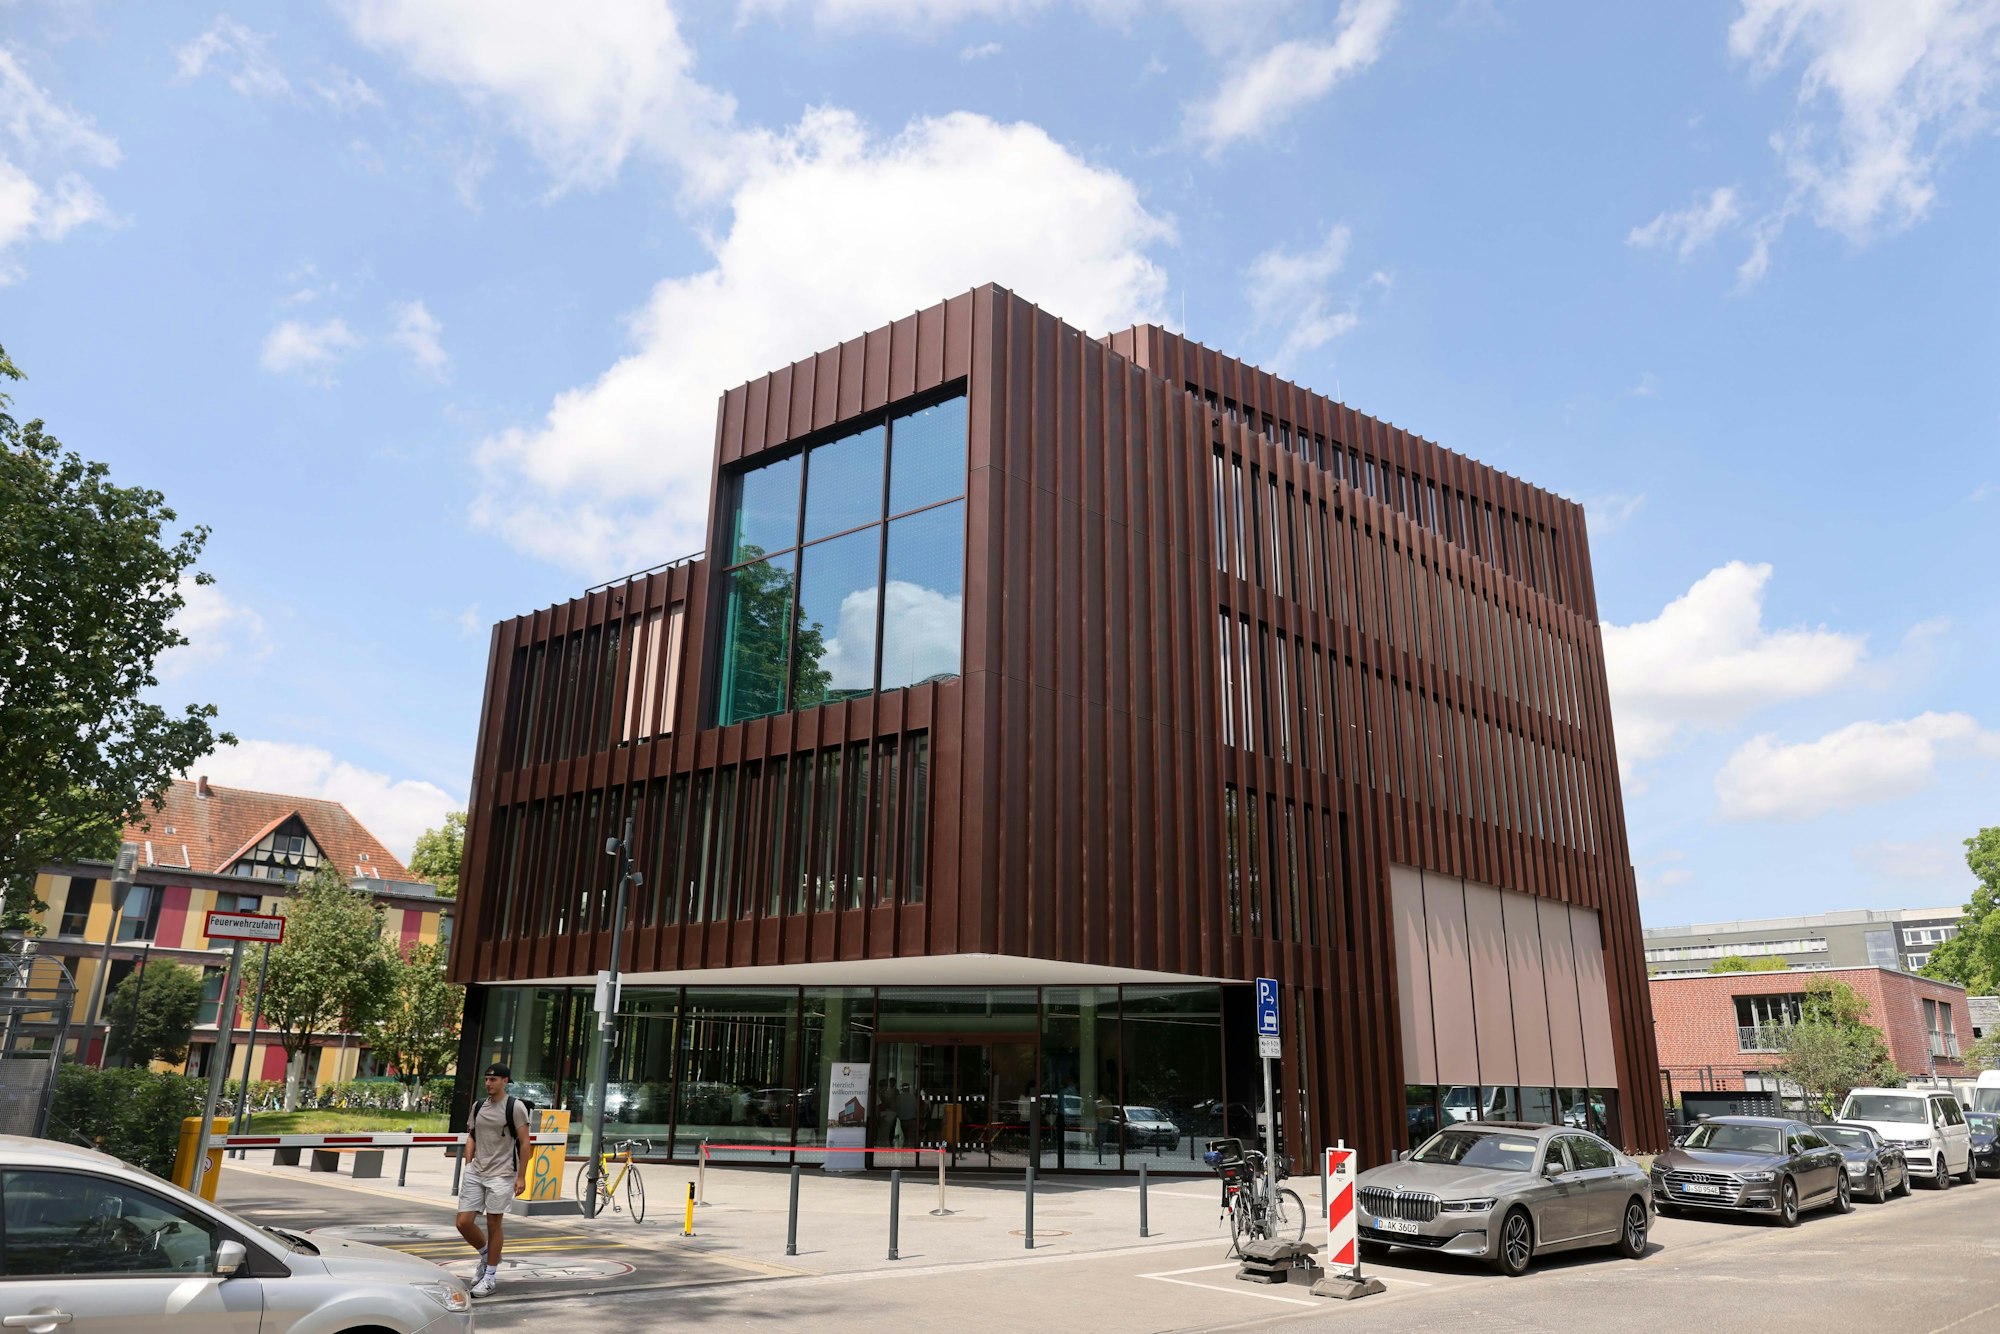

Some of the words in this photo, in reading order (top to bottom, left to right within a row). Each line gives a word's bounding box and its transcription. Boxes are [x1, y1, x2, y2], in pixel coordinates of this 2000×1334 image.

[210, 915, 280, 930] Feuerwehrzufahrt
[1260, 982, 1270, 1004] P
[1378, 1219, 1384, 1229] D
[1387, 1221, 1397, 1231] AK
[1398, 1222, 1417, 1234] 3602
